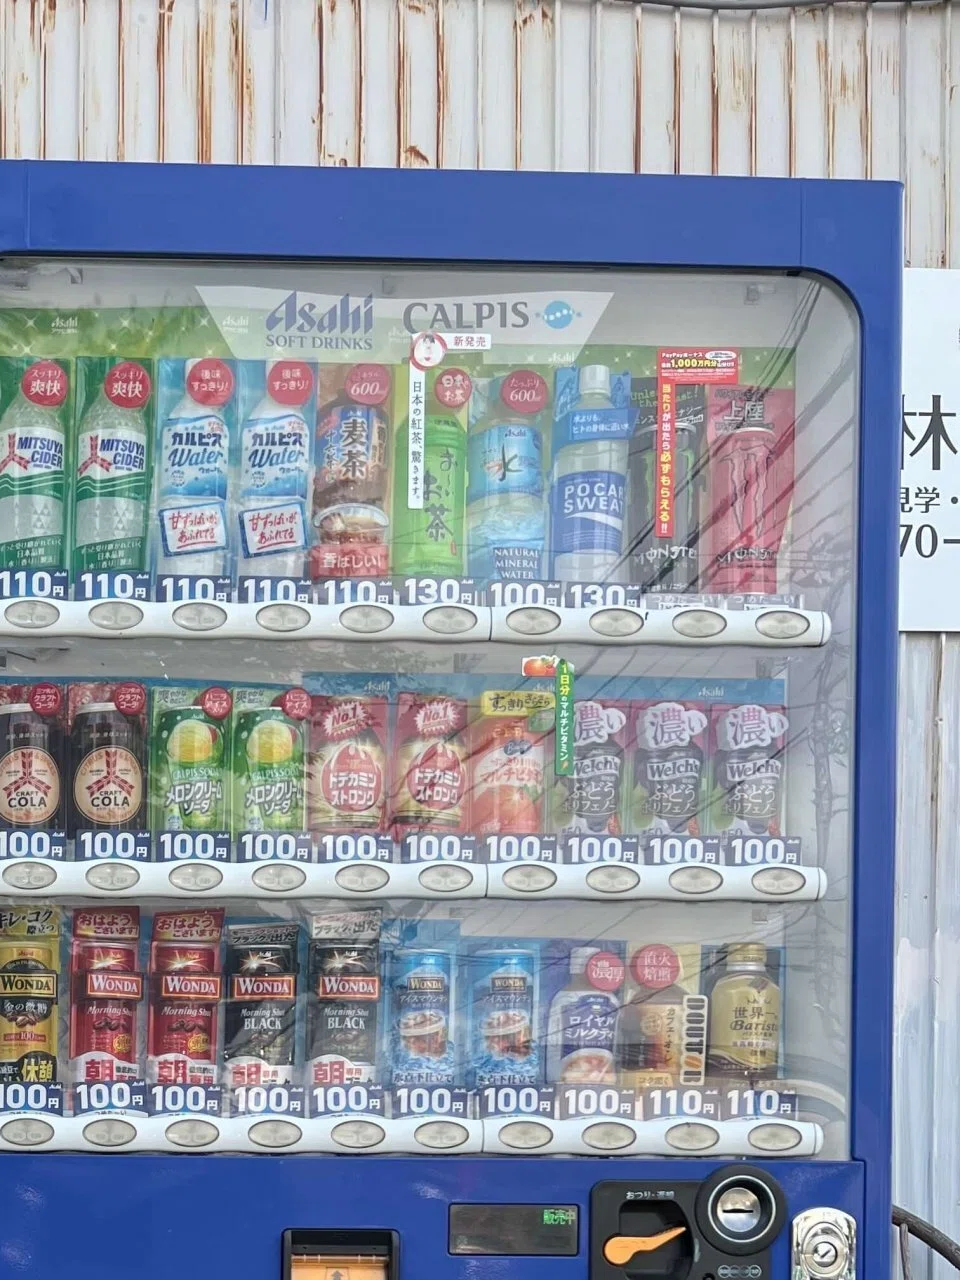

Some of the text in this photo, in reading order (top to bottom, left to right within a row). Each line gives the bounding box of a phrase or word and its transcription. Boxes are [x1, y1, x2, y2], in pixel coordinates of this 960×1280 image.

[265, 290, 530, 334] Asahi CALPIS
[51, 316, 78, 328] Asahi
[266, 334, 374, 351] SOFT DRINKS
[453, 335, 487, 348] 新発売
[32, 369, 61, 378] スッキリ
[113, 371, 143, 379] スッキリ
[30, 379, 61, 396] 爽快
[112, 381, 142, 397] 爽快
[171, 432, 223, 447] カルピス
[251, 432, 304, 447] カルピス
[410, 381, 424, 500] 日本の紅茶、驚きます。
[505, 428, 526, 437] Asahi
[17, 436, 63, 456] MITSUYA
[100, 439, 145, 457] MITSUYA
[342, 418, 368, 481] 麦茶
[31, 450, 62, 469] CIDER
[113, 452, 144, 471] CIDER
[168, 448, 223, 467] Water
[249, 448, 304, 468] Water
[424, 470, 454, 542] お茶
[495, 549, 539, 558] NATURAL
[495, 559, 538, 569] MINERAL
[500, 569, 534, 580] WATER
[81, 573, 146, 598] 110円
[162, 577, 227, 602] 110円
[244, 578, 308, 602] 110円
[324, 579, 389, 604] 110円
[405, 578, 472, 605] 130円
[491, 582, 558, 607] 100円
[571, 584, 637, 608] 130円
[423, 704, 448, 721] No.1
[489, 694, 524, 712] すっきり
[559, 664, 570, 761] 1日分のマルチビタミン
[331, 703, 358, 725] No.1
[651, 707, 706, 744] 濃い
[730, 708, 786, 747] 濃い
[414, 768, 460, 786] ドデカミン
[648, 759, 700, 777] Welch's
[727, 760, 781, 778] Welch's
[329, 771, 377, 788] ドデカミン
[164, 781, 223, 806] メロンクリーム
[246, 781, 303, 807] メロンクリーム
[573, 782, 616, 800] ぶどう
[651, 782, 696, 802] ぶどう
[732, 783, 776, 803] ぶどう
[8, 796, 47, 808] COLA
[91, 796, 130, 807] COLA
[182, 800, 211, 814] ソーダ
[264, 800, 291, 814] ソーダ
[80, 832, 148, 859] 100円
[159, 833, 227, 859] 100円
[241, 834, 308, 859] 100円
[322, 835, 389, 860] 100円
[406, 835, 473, 860] 100円
[486, 836, 553, 861] 100円
[568, 837, 635, 862] 100円
[650, 838, 716, 863] 100円
[731, 838, 797, 864] 100円
[79, 913, 132, 927] おはよう
[157, 917, 213, 930] おはよう
[644, 951, 671, 967] 直火
[0, 974, 51, 991] WONDA
[91, 974, 138, 993] WONDA
[167, 975, 216, 993] WONDA
[239, 977, 289, 993] WONDA
[324, 977, 375, 993] WONDA
[410, 978, 442, 989] WONDA
[495, 978, 525, 989] WONDA
[244, 1018, 282, 1030] BLACK
[327, 1018, 366, 1030] BLACK
[570, 1014, 615, 1026] ロイヤル
[76, 1083, 143, 1108] 100円
[152, 1086, 218, 1111] 100円
[234, 1086, 301, 1112] 100円
[313, 1085, 381, 1112] 100円
[396, 1088, 464, 1113] 100円
[484, 1087, 551, 1113] 100円
[564, 1089, 631, 1115] 100円
[649, 1089, 715, 1114] 110円
[727, 1089, 792, 1115] 110円
[543, 1208, 576, 1225] 販売中
